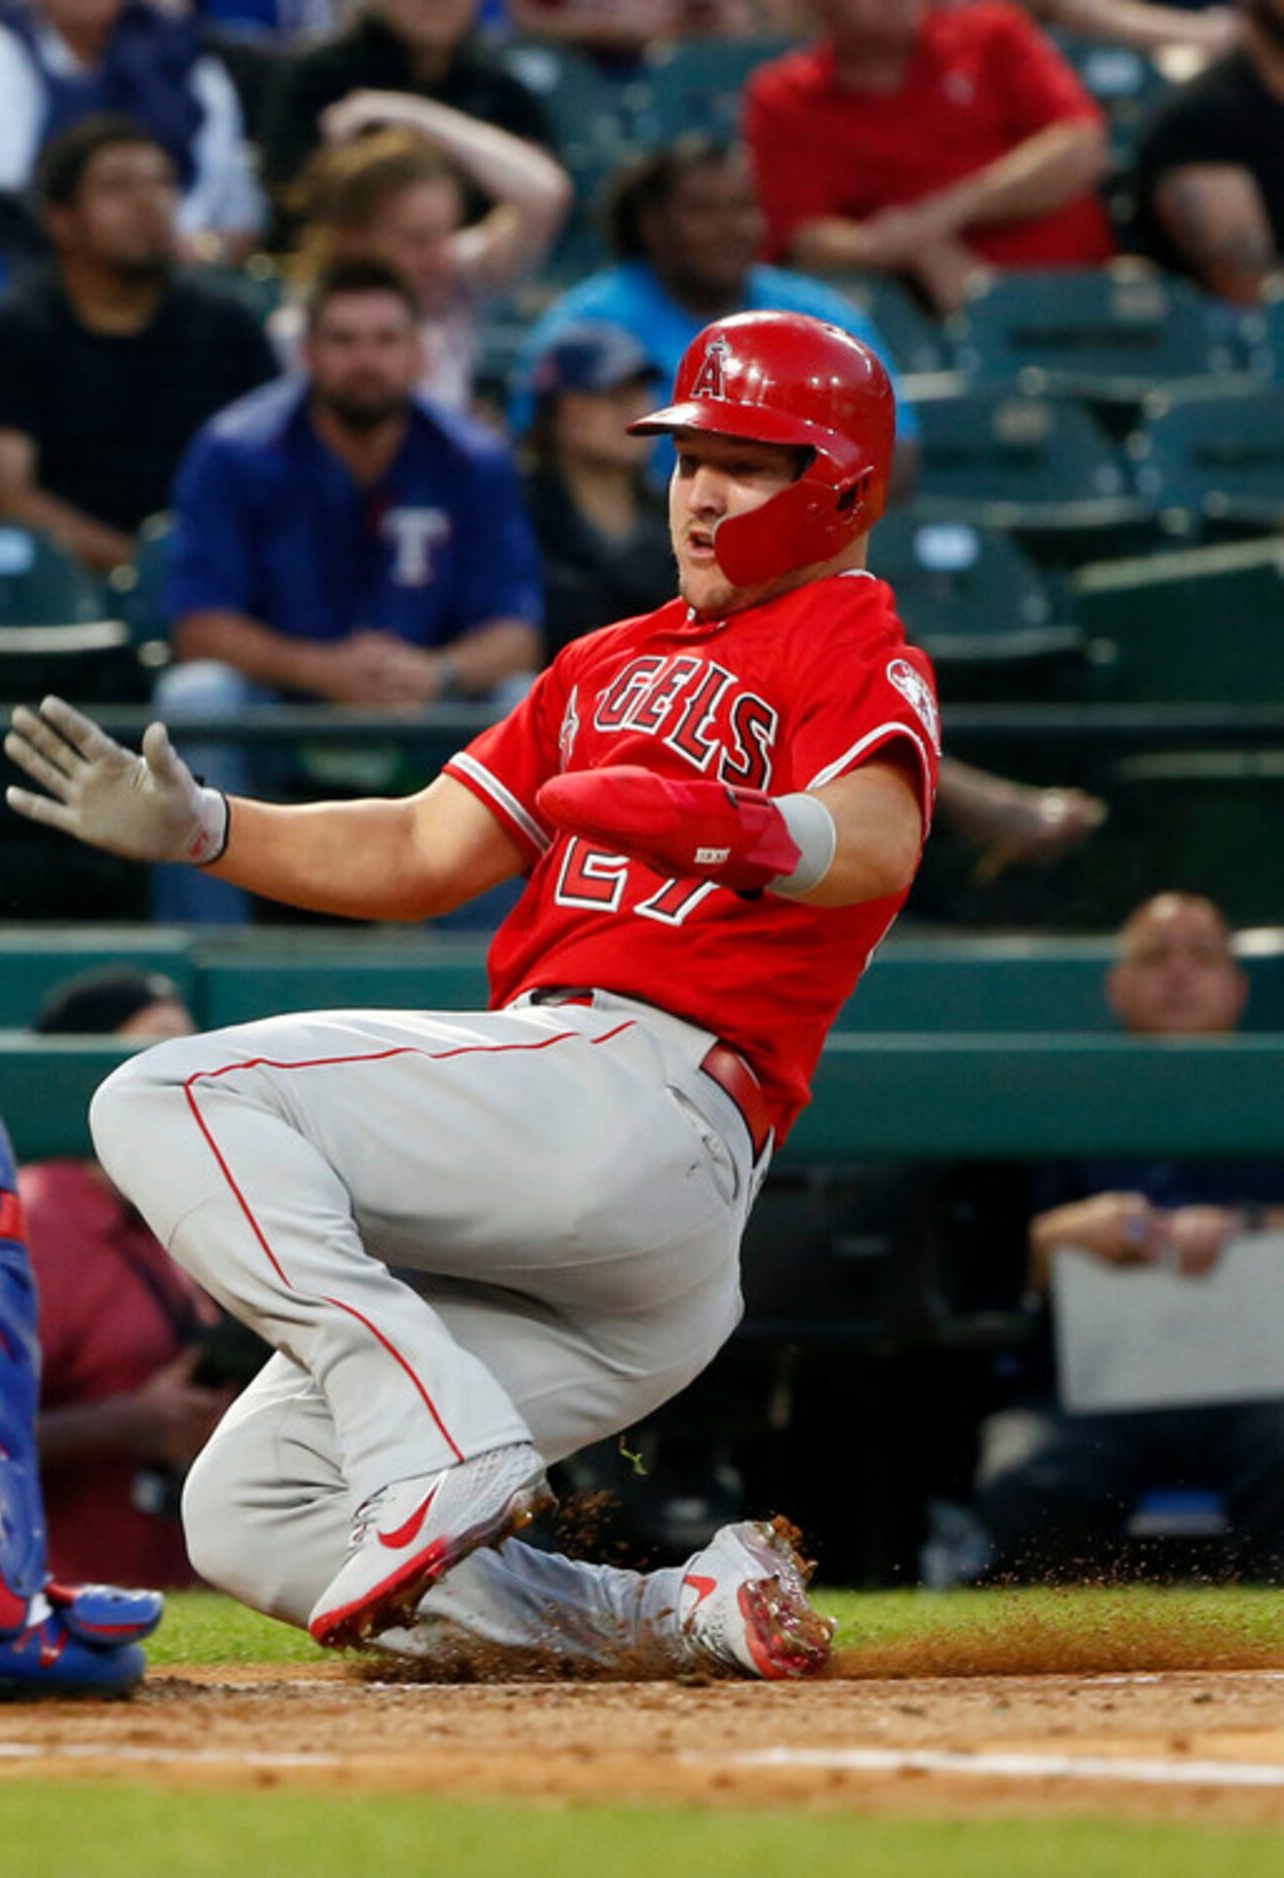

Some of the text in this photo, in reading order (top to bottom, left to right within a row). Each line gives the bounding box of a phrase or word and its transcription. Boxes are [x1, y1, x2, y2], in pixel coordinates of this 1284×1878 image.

[689, 341, 730, 401] A
[378, 506, 452, 588] T
[559, 655, 779, 793] GELS
